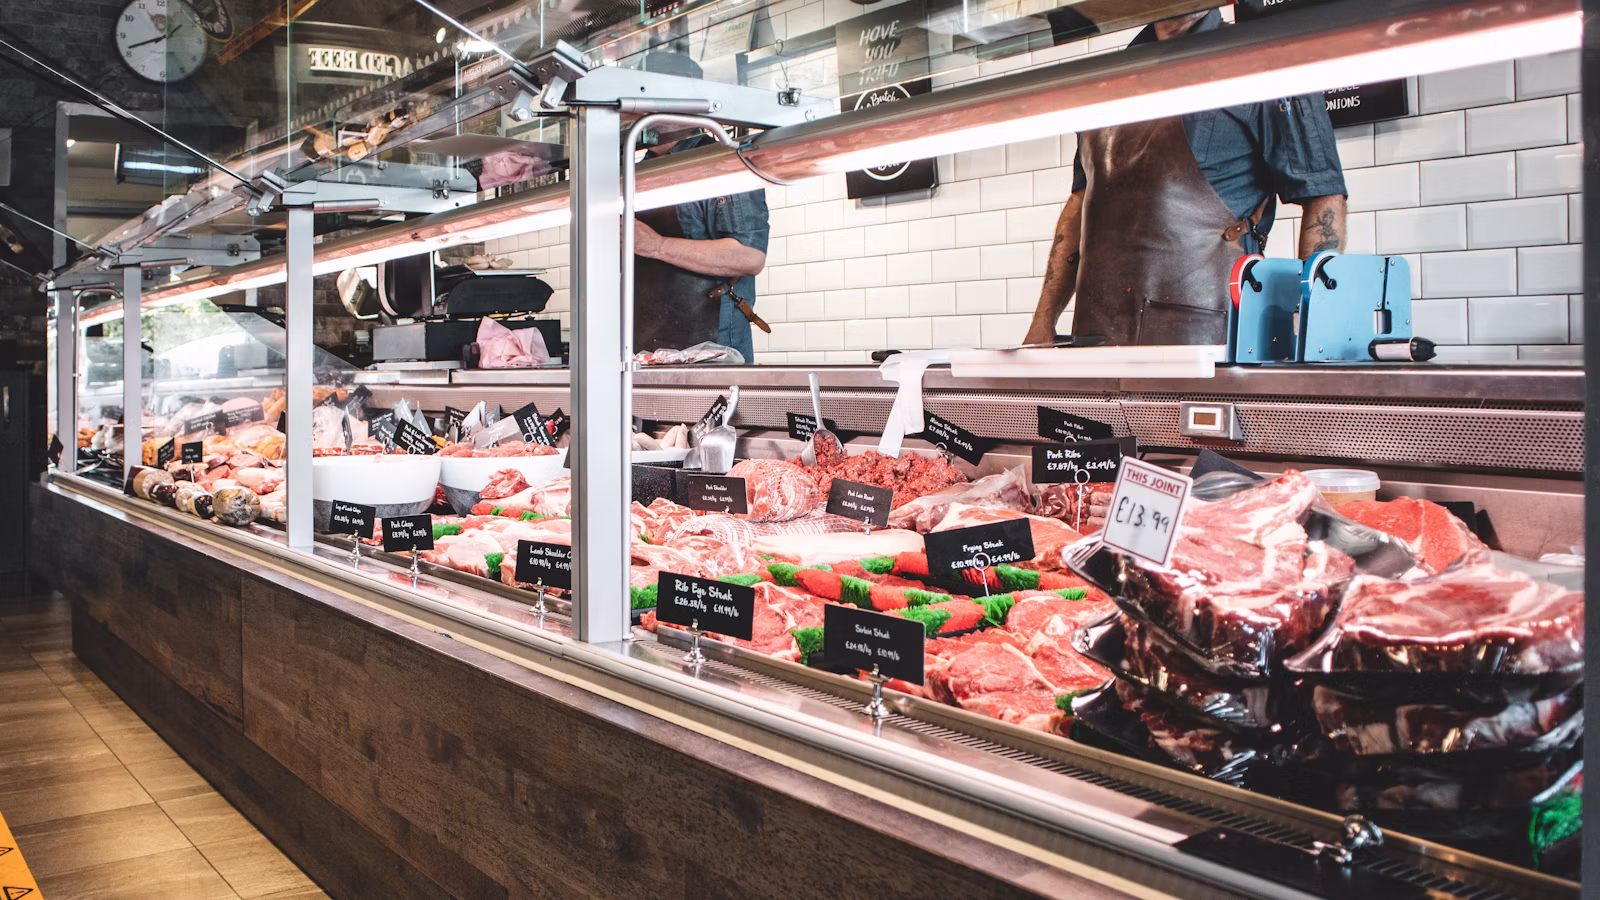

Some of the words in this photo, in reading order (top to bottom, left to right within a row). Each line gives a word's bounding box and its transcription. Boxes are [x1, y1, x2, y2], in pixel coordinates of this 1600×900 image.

[859, 19, 900, 47] HAVE
[1046, 449, 1064, 460] Pork
[1064, 449, 1082, 459] Ribs
[1126, 468, 1149, 484] THIS
[1150, 478, 1182, 495] JOINT
[1116, 496, 1169, 534] £13.99
[390, 521, 401, 529] Pork
[401, 520, 414, 529] Chops
[530, 545, 544, 555] Lamb
[545, 547, 566, 558] Shoulder
[962, 544, 982, 553] Frying
[983, 540, 1004, 549] Steak
[674, 579, 689, 592] Rib
[691, 582, 707, 598] Eye
[708, 586, 733, 601] Steak
[674, 596, 707, 612] £26.38/kg
[855, 624, 872, 635] Sirloin
[873, 628, 890, 639] Steak
